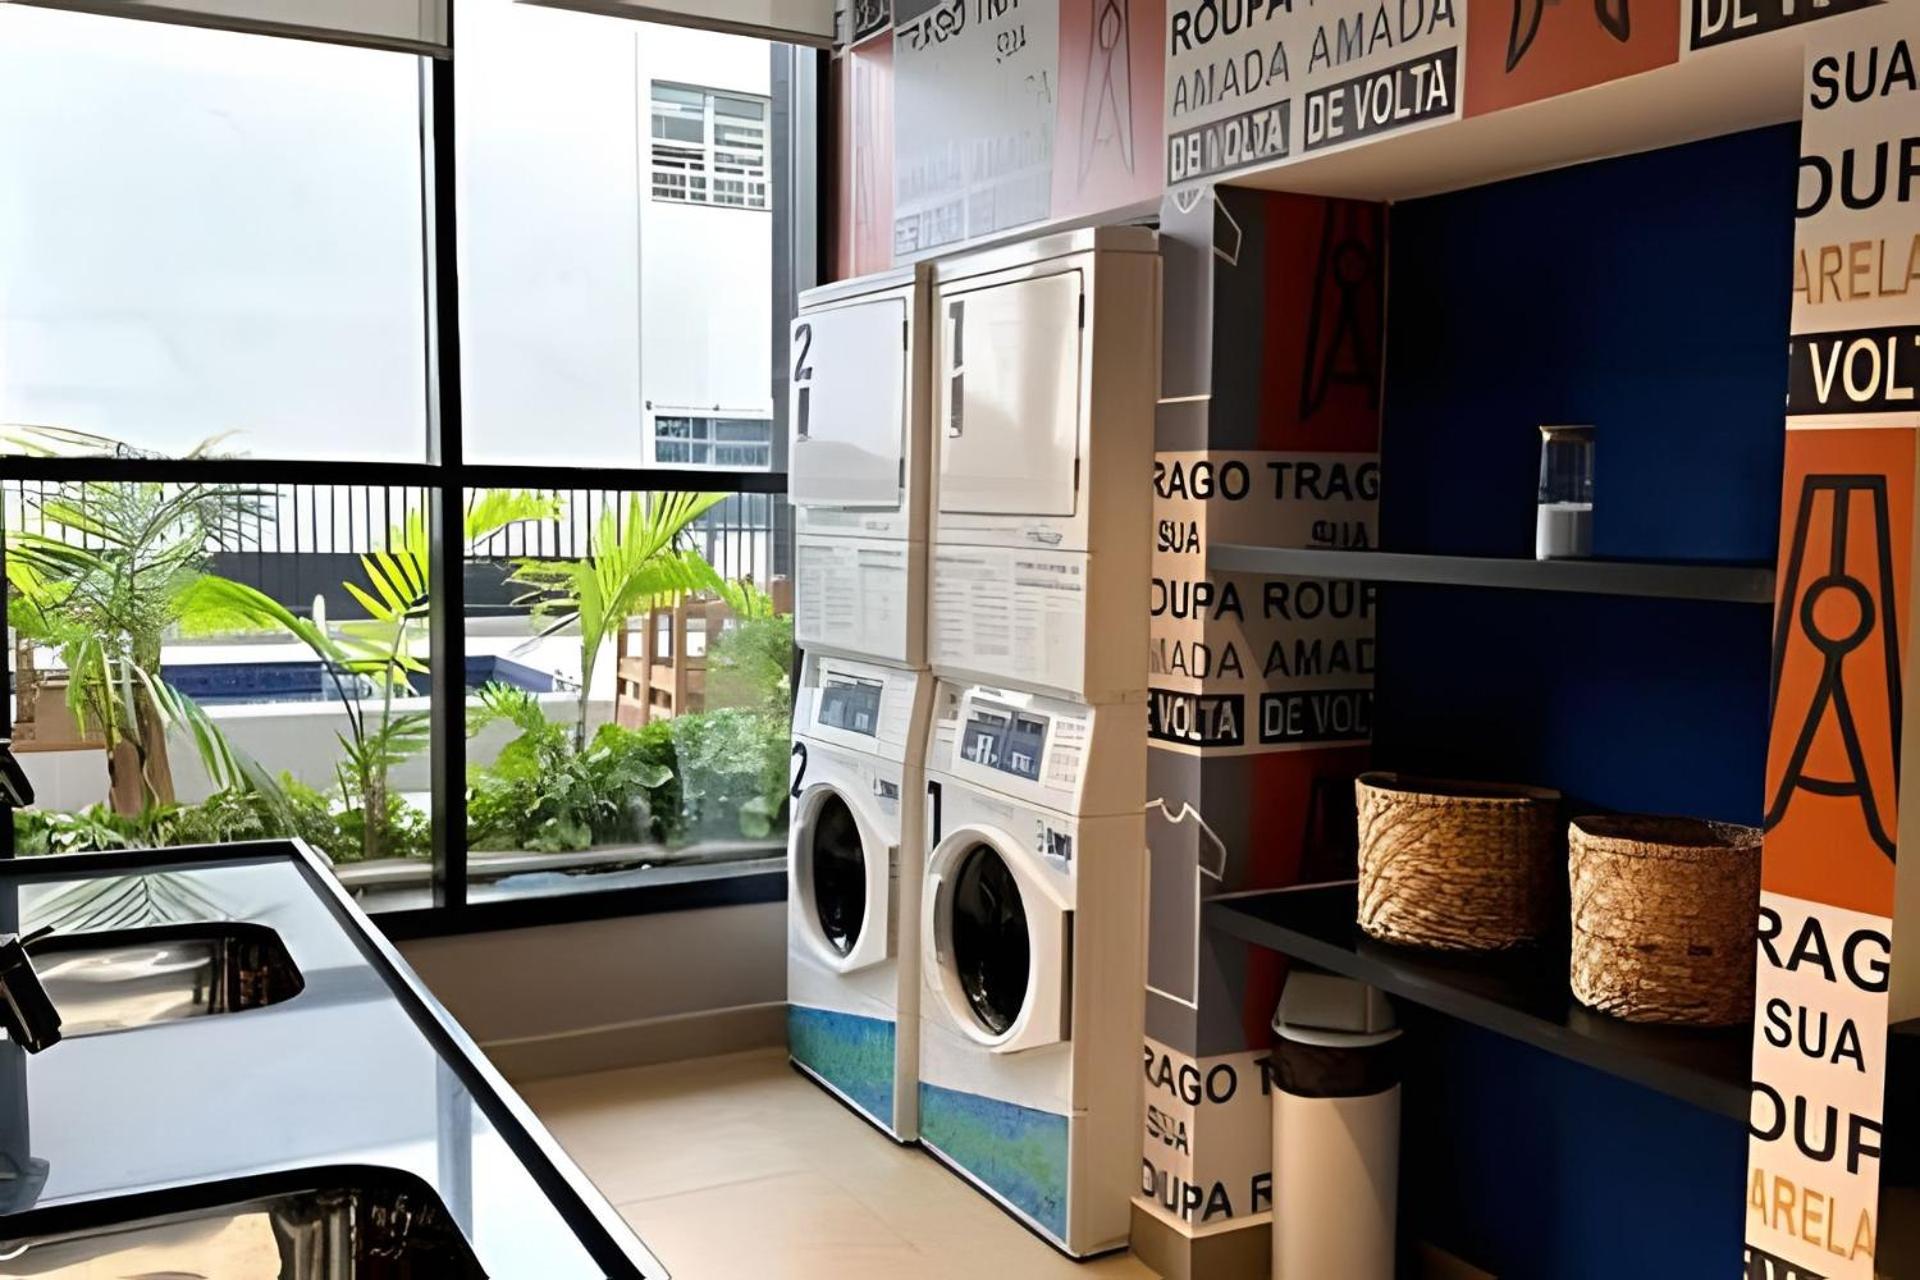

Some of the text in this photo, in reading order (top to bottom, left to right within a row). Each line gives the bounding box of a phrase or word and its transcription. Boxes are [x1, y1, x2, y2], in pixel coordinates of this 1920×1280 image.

[1308, 0, 1457, 74] AMADA
[1308, 88, 1345, 145] DE
[1354, 58, 1449, 130] VOLTA
[1810, 39, 1919, 110] SUA
[1809, 335, 1920, 404] VOL
[1158, 693, 1238, 740] VOLTA
[1264, 697, 1304, 737] DE
[1311, 692, 1374, 736] VOL
[1763, 998, 1866, 1073] SUA
